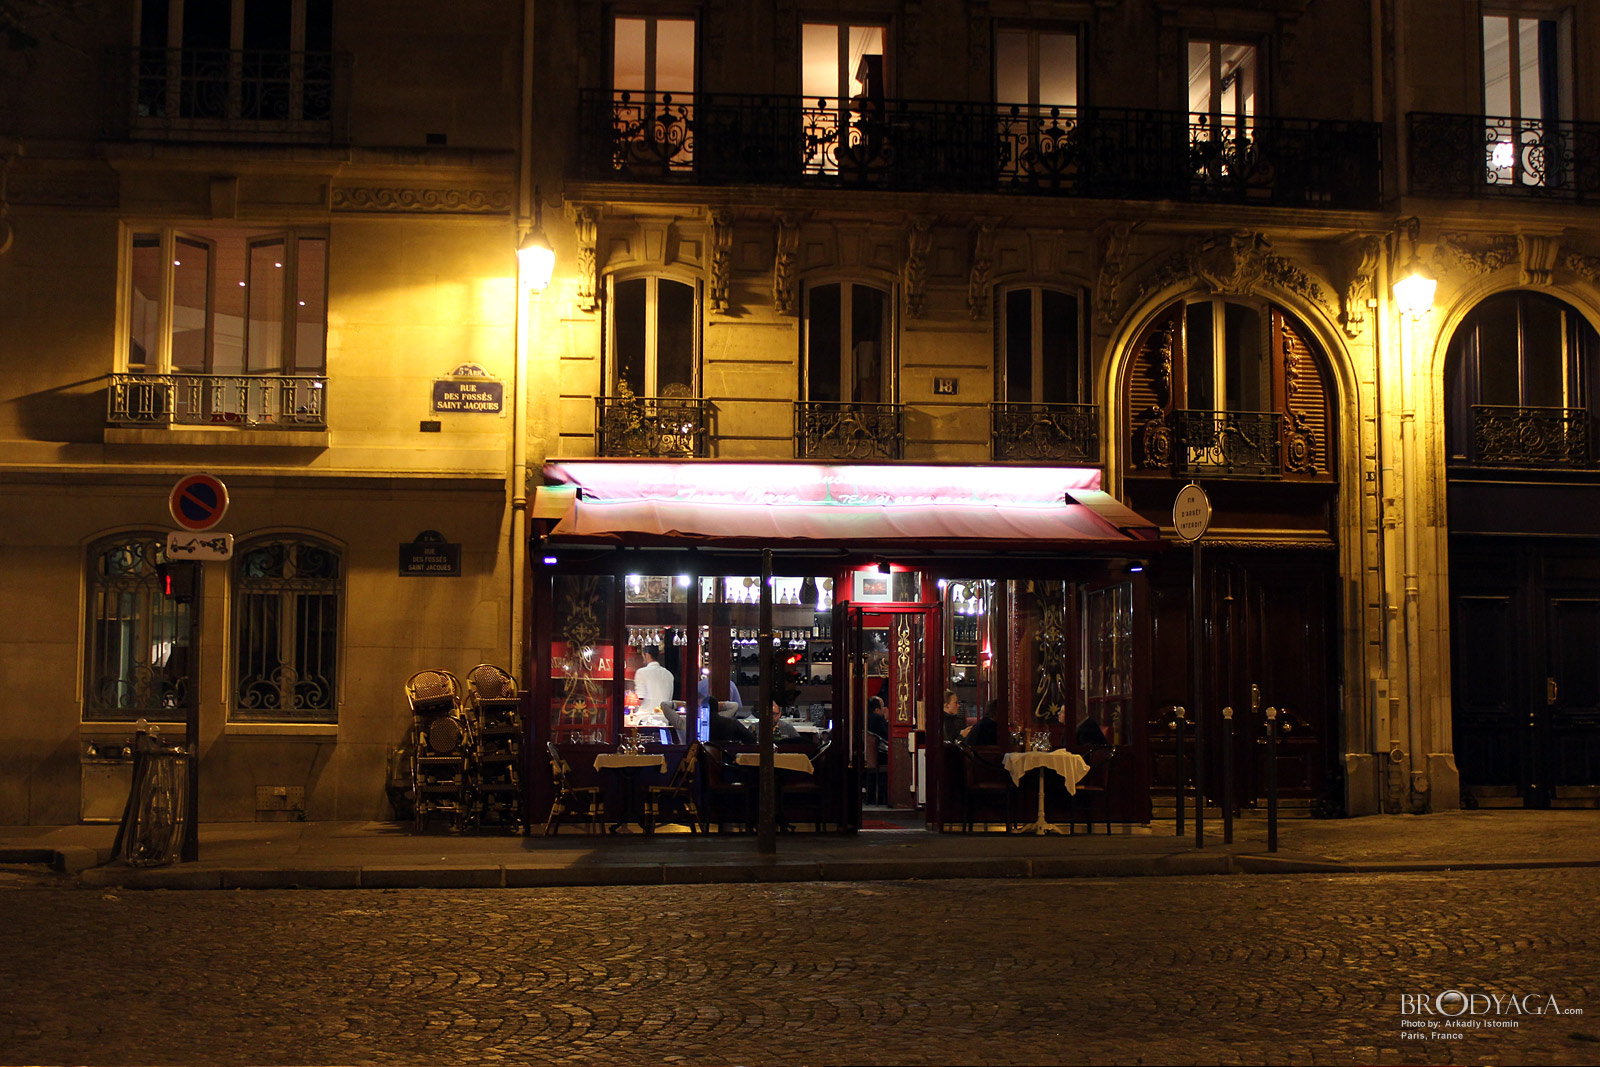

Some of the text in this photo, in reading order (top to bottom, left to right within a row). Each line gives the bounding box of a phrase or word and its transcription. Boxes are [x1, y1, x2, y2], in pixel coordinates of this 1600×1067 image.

[460, 384, 477, 392] RUE
[444, 392, 493, 401] DES FOSSÉS
[437, 401, 499, 411] SAINT JACQUES
